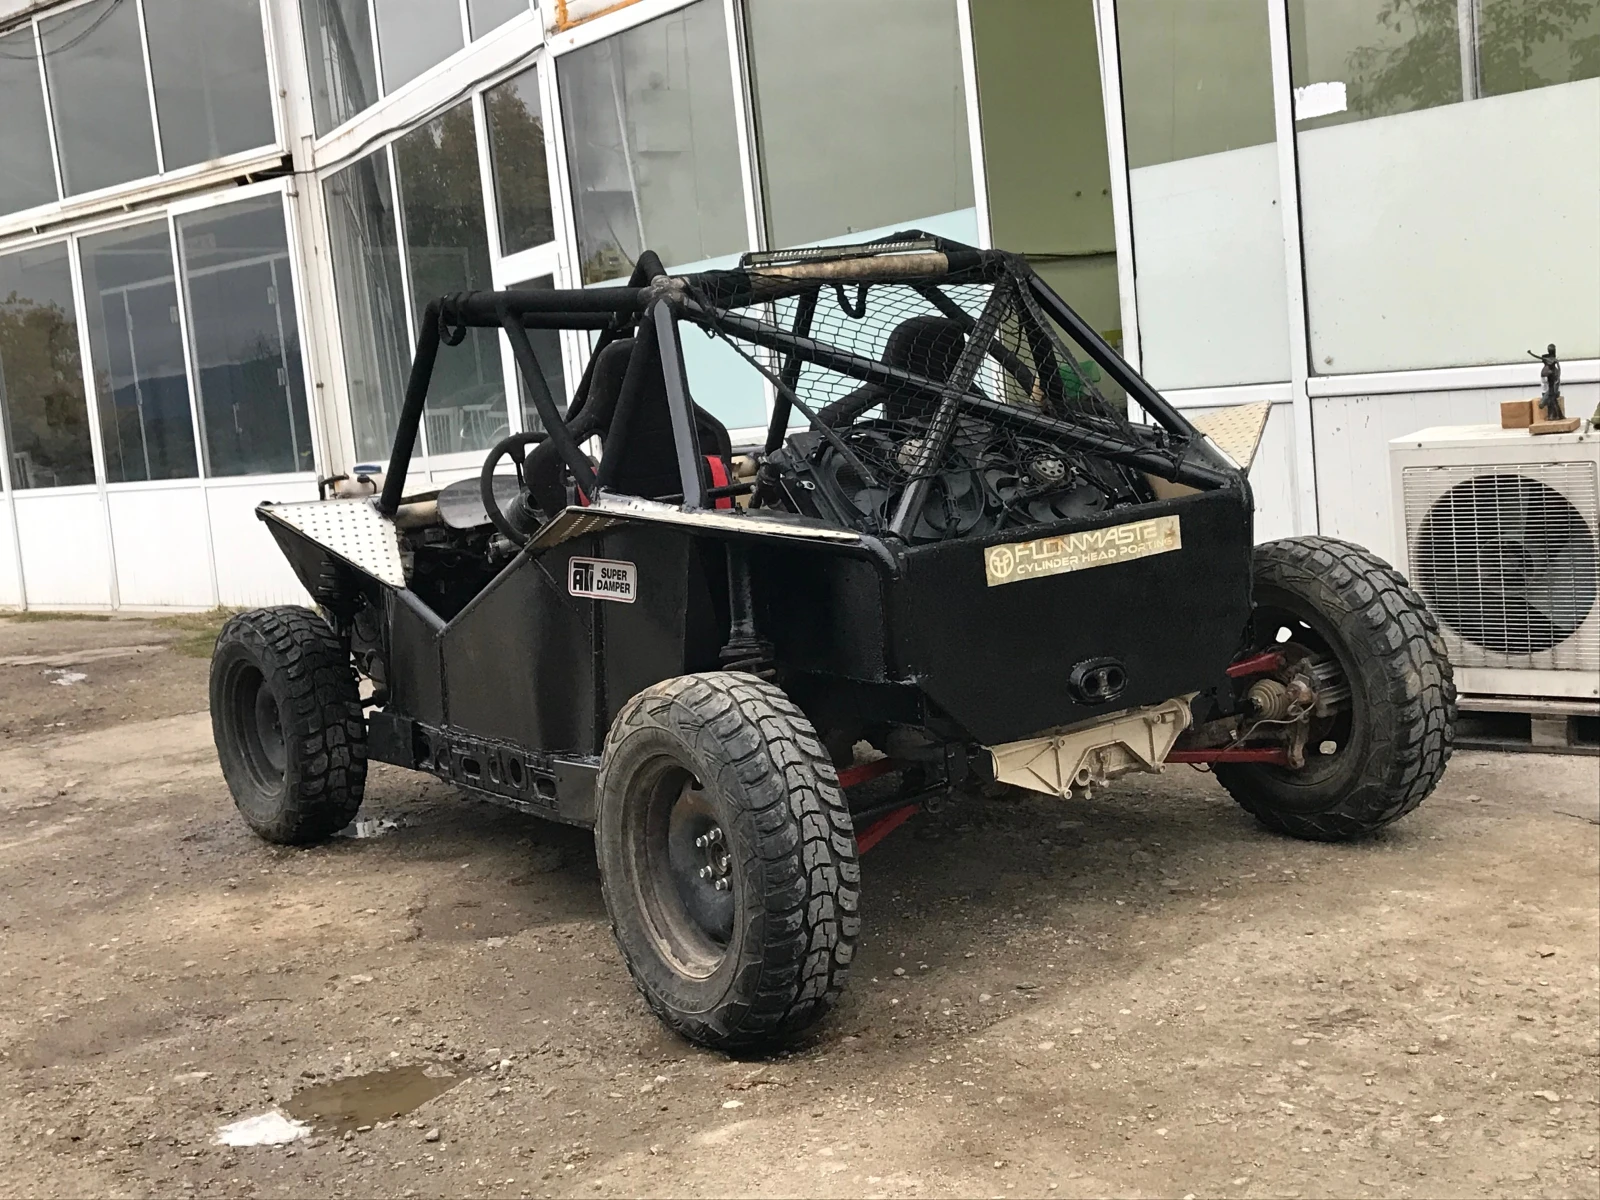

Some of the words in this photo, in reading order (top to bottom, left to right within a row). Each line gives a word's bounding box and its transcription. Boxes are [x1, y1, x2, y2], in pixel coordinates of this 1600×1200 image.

[1014, 521, 1172, 562] FLOWMASTE
[1017, 555, 1079, 574] CYLINDER
[1082, 549, 1117, 563] HEAD
[1119, 537, 1172, 555] PORTING
[601, 567, 628, 581] SUPER
[596, 580, 631, 594] DAMPER
